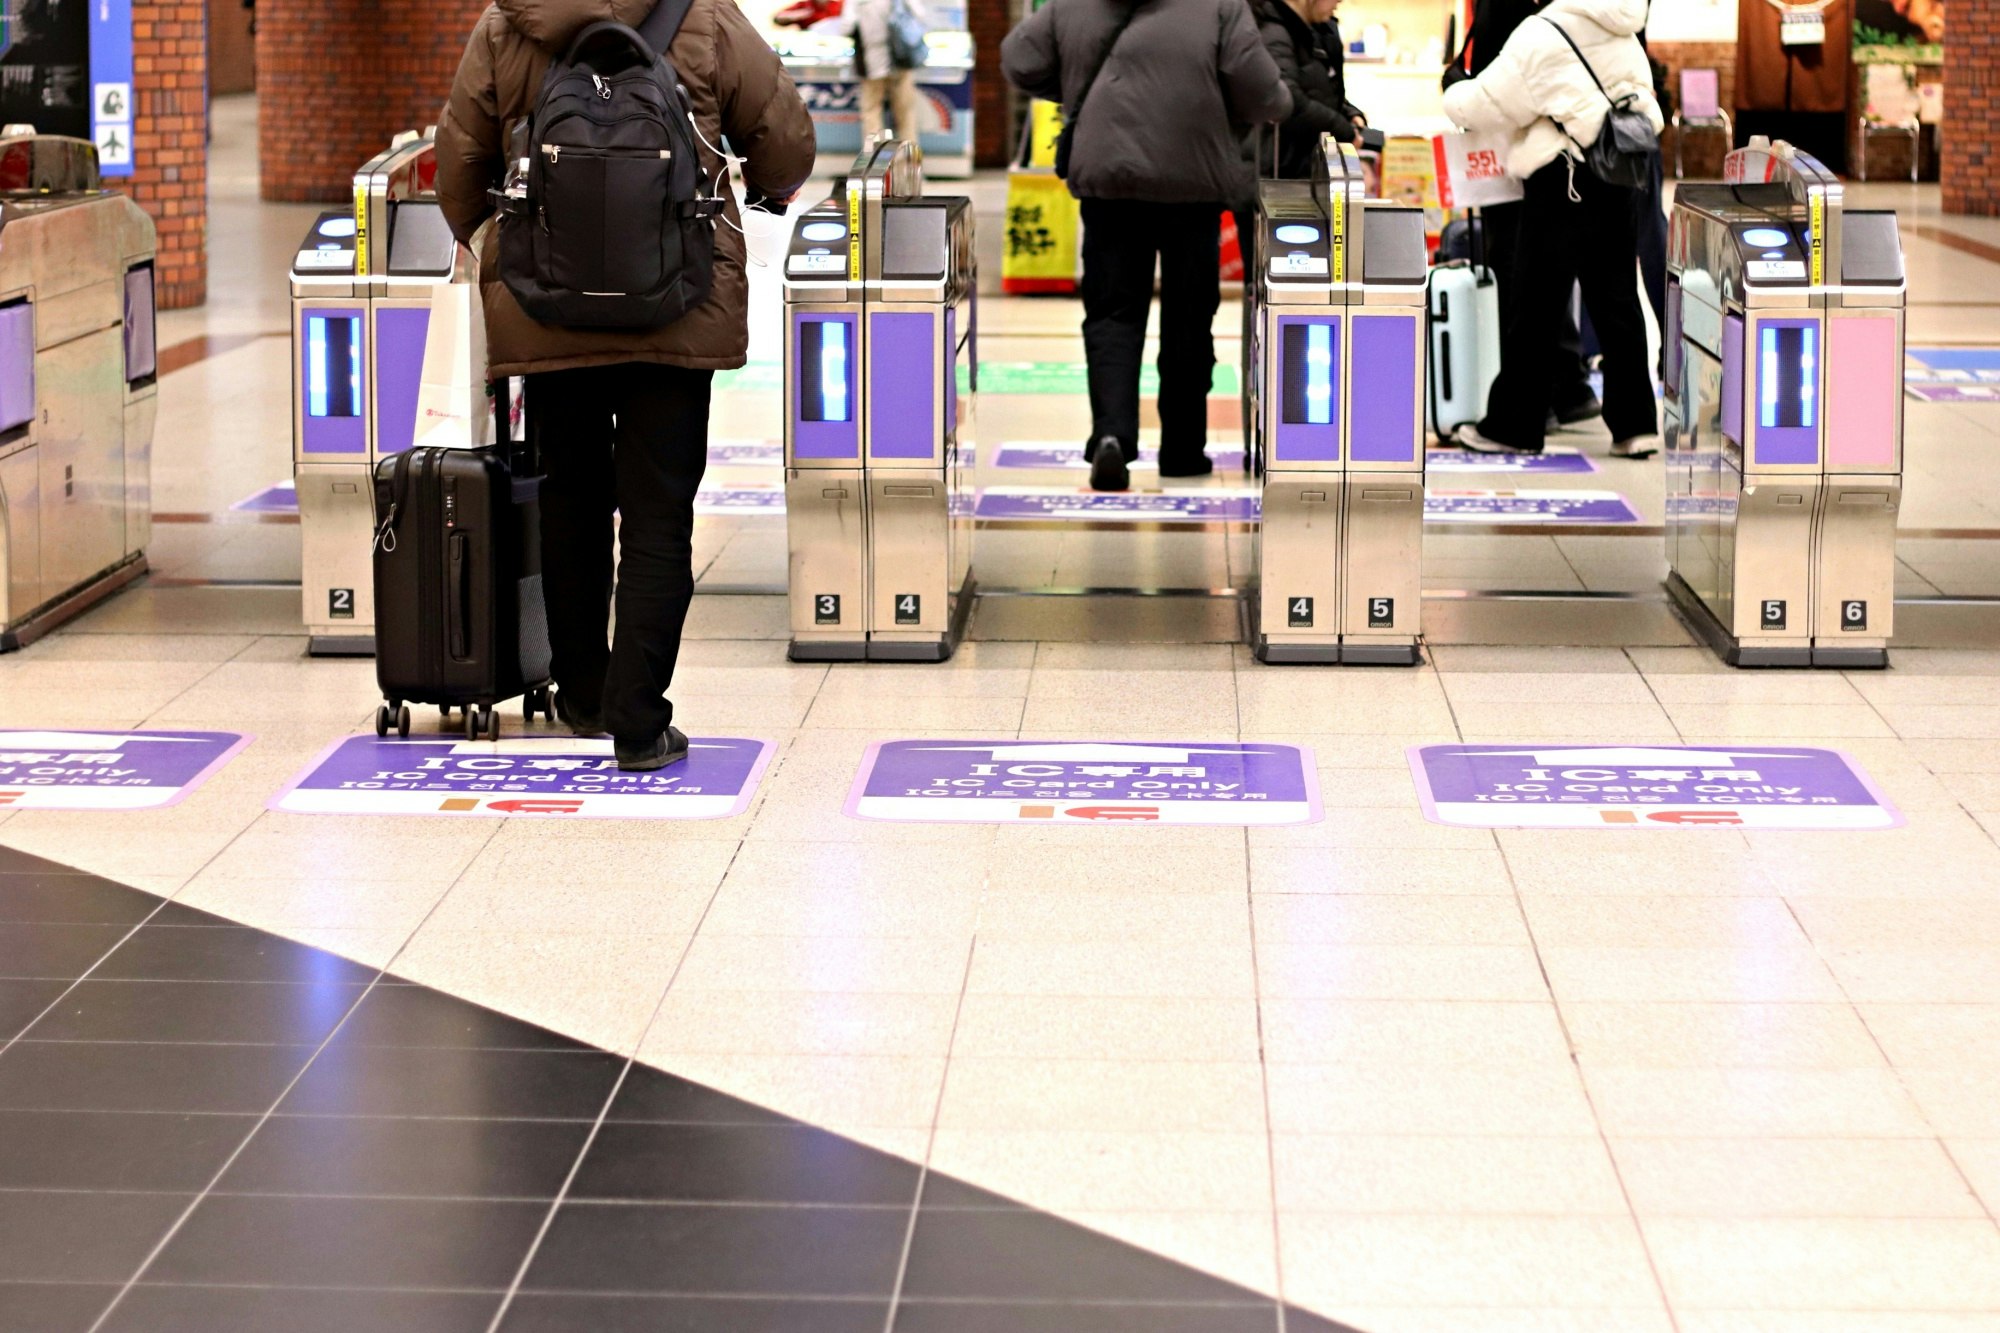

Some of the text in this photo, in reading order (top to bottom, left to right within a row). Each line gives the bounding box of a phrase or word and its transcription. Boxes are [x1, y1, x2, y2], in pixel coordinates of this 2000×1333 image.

[1467, 149, 1497, 169] 551
[333, 589, 350, 609] 2
[819, 595, 836, 615] 3
[898, 595, 916, 614] 4
[1292, 598, 1309, 617] 4
[1373, 599, 1389, 618] 5
[1765, 601, 1782, 620] 5
[1846, 602, 1862, 621] 6
[29, 766, 137, 776] Only
[371, 771, 682, 785] IC Card Only
[968, 763, 1206, 778] IC専用
[931, 778, 1241, 791] IC Card Only
[1493, 783, 1802, 795] IC Card Only
